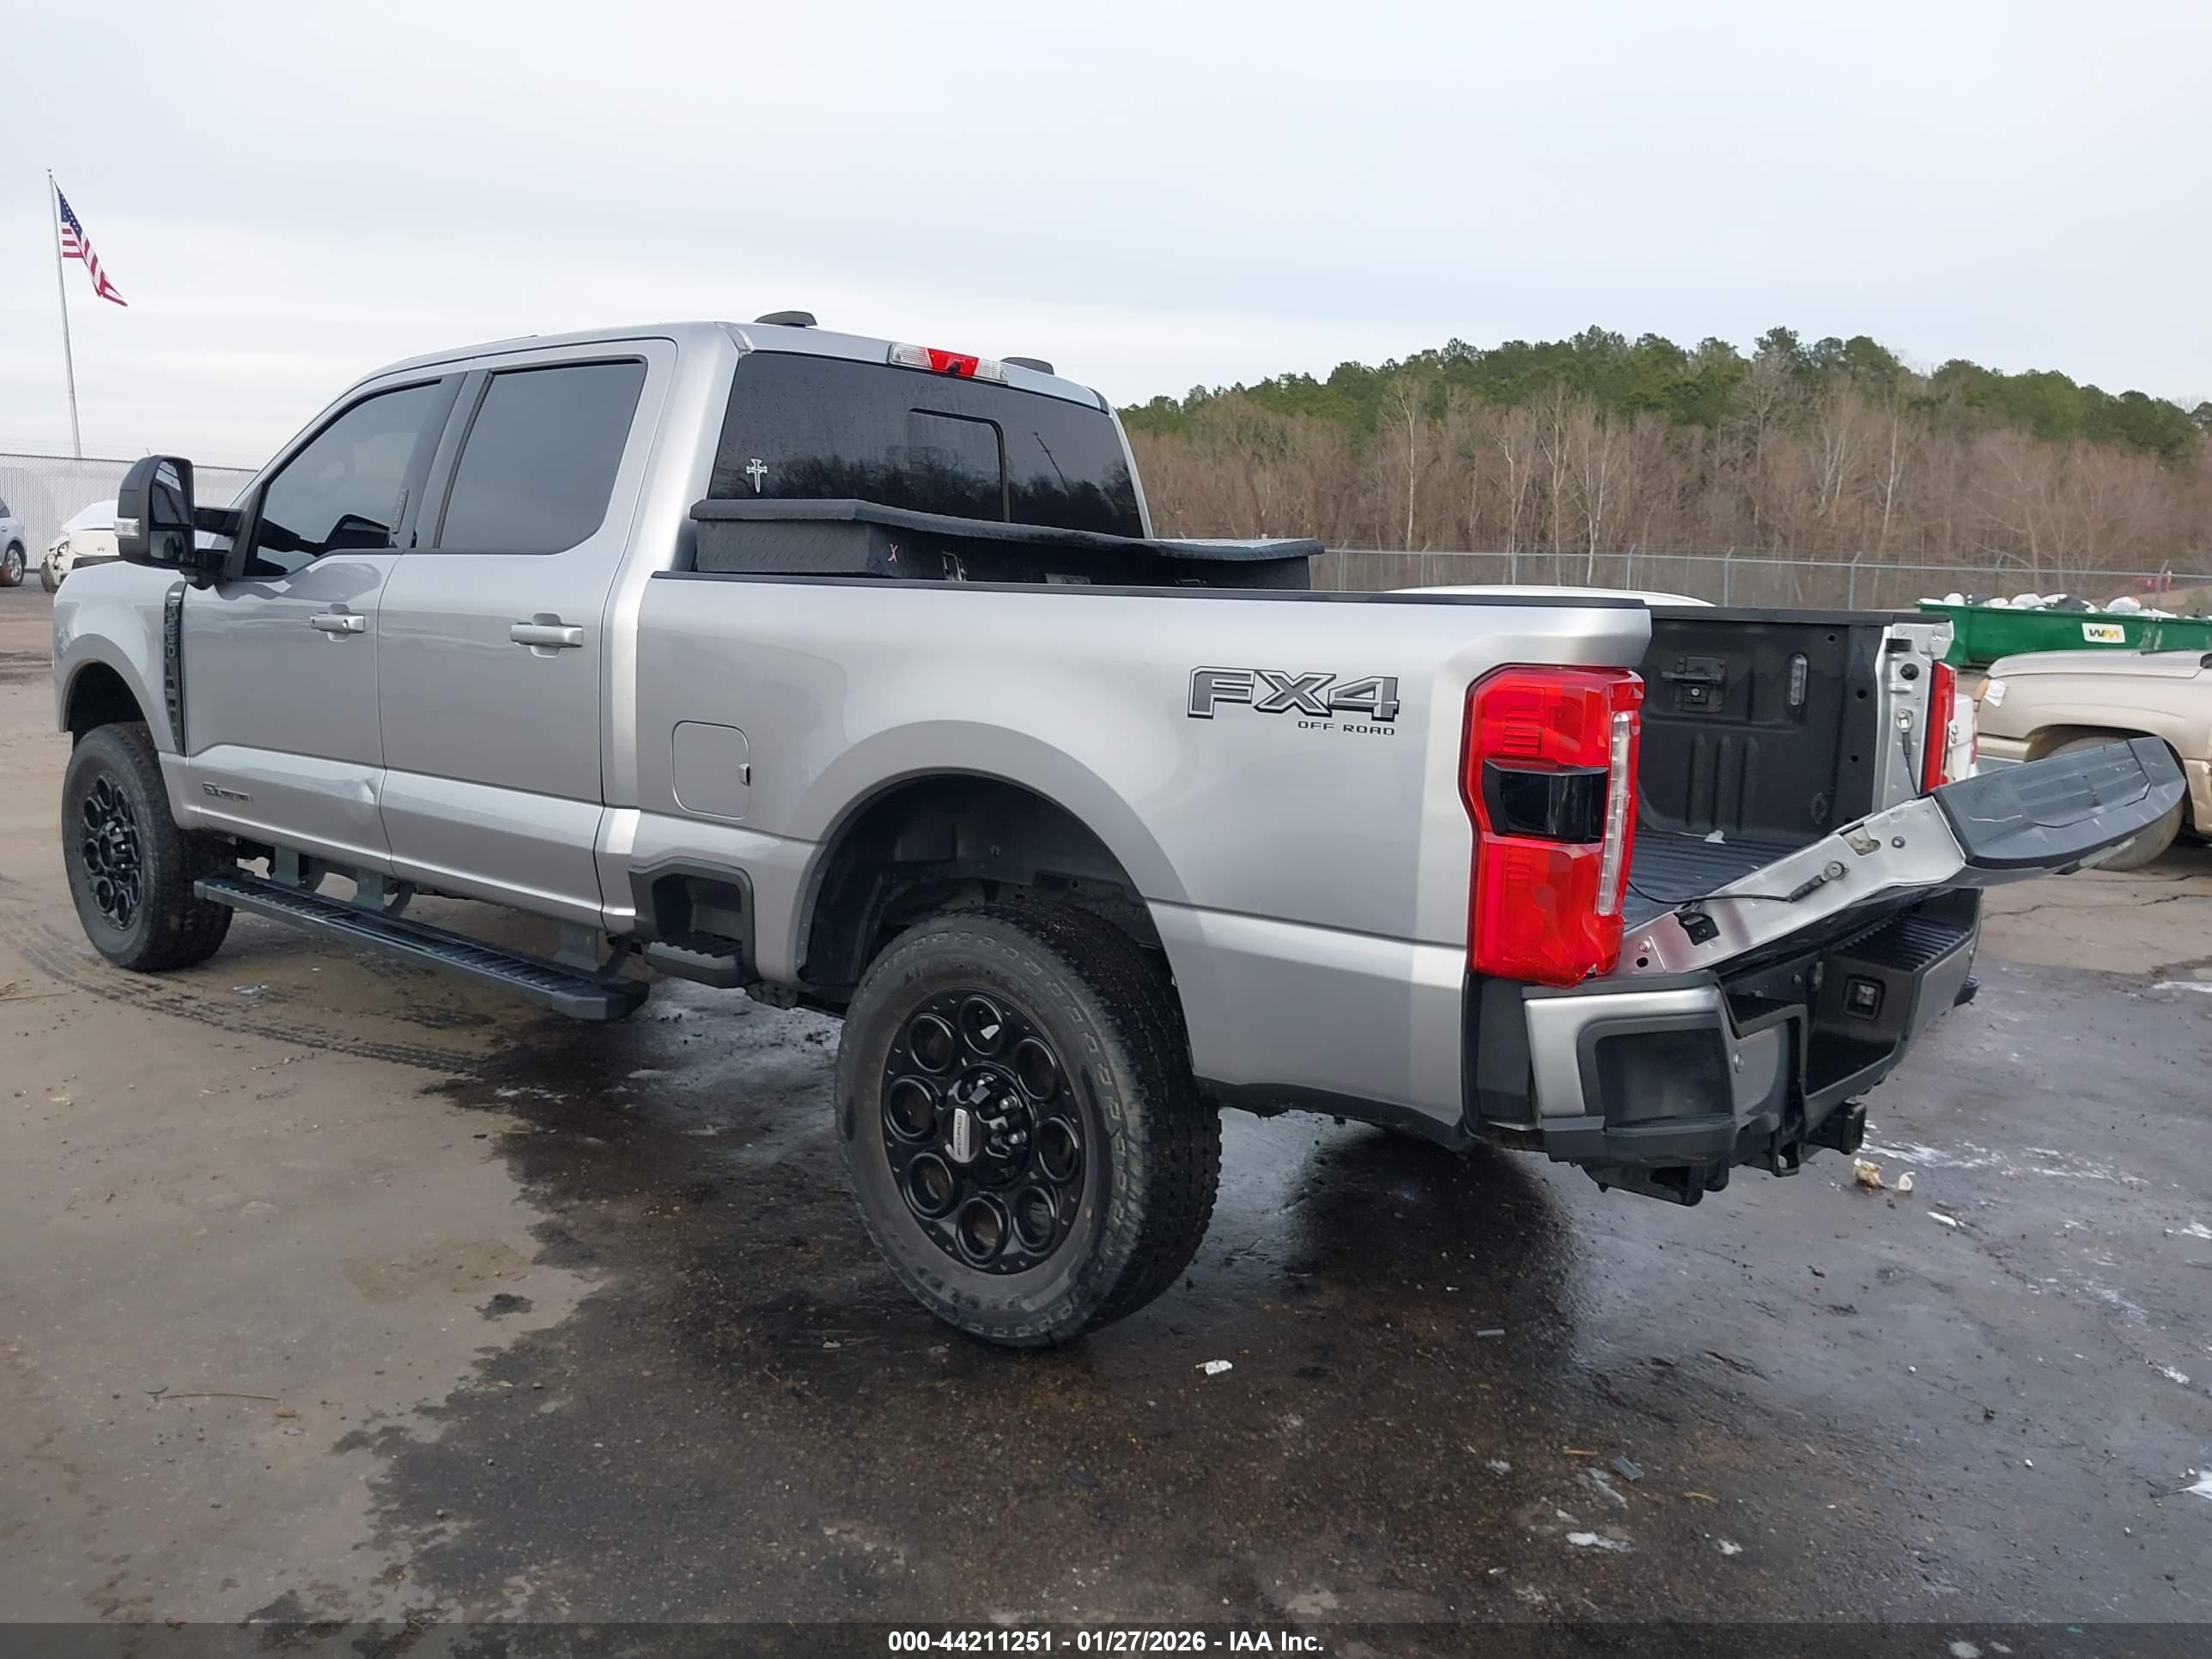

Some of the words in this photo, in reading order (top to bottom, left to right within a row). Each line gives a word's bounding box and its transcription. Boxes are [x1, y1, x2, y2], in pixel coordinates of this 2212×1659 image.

[2089, 629, 2118, 638] WM
[1188, 666, 1399, 721] FX4
[1297, 720, 1334, 730] OFF
[1342, 724, 1395, 736] ROAD
